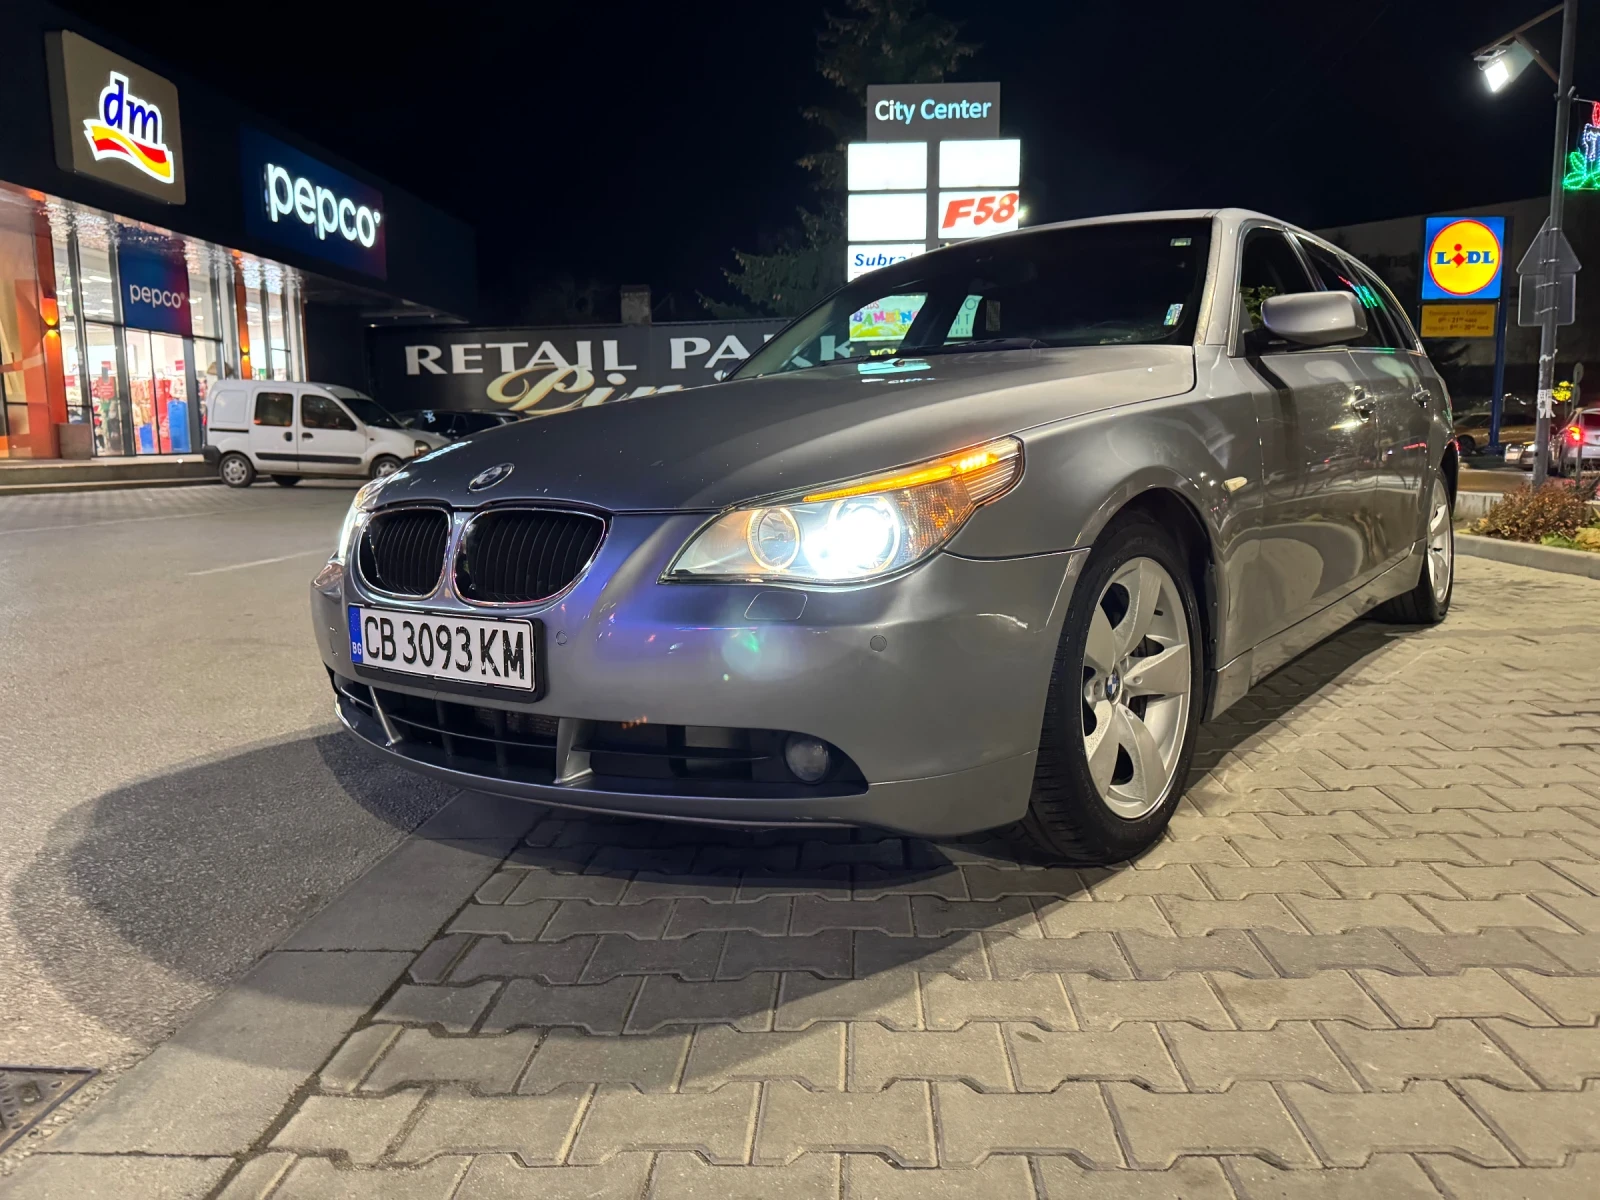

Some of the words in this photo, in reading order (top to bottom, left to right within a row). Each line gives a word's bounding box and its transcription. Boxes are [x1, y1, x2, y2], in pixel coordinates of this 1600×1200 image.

[103, 77, 159, 145] dm
[875, 99, 915, 125] City
[920, 98, 992, 120] Center
[942, 192, 1019, 229] F58
[129, 283, 182, 309] pepco
[404, 339, 638, 376] RETAIL
[352, 641, 362, 655] BG
[364, 615, 397, 661] CB
[402, 620, 473, 672] 3093
[479, 627, 525, 680] KM
